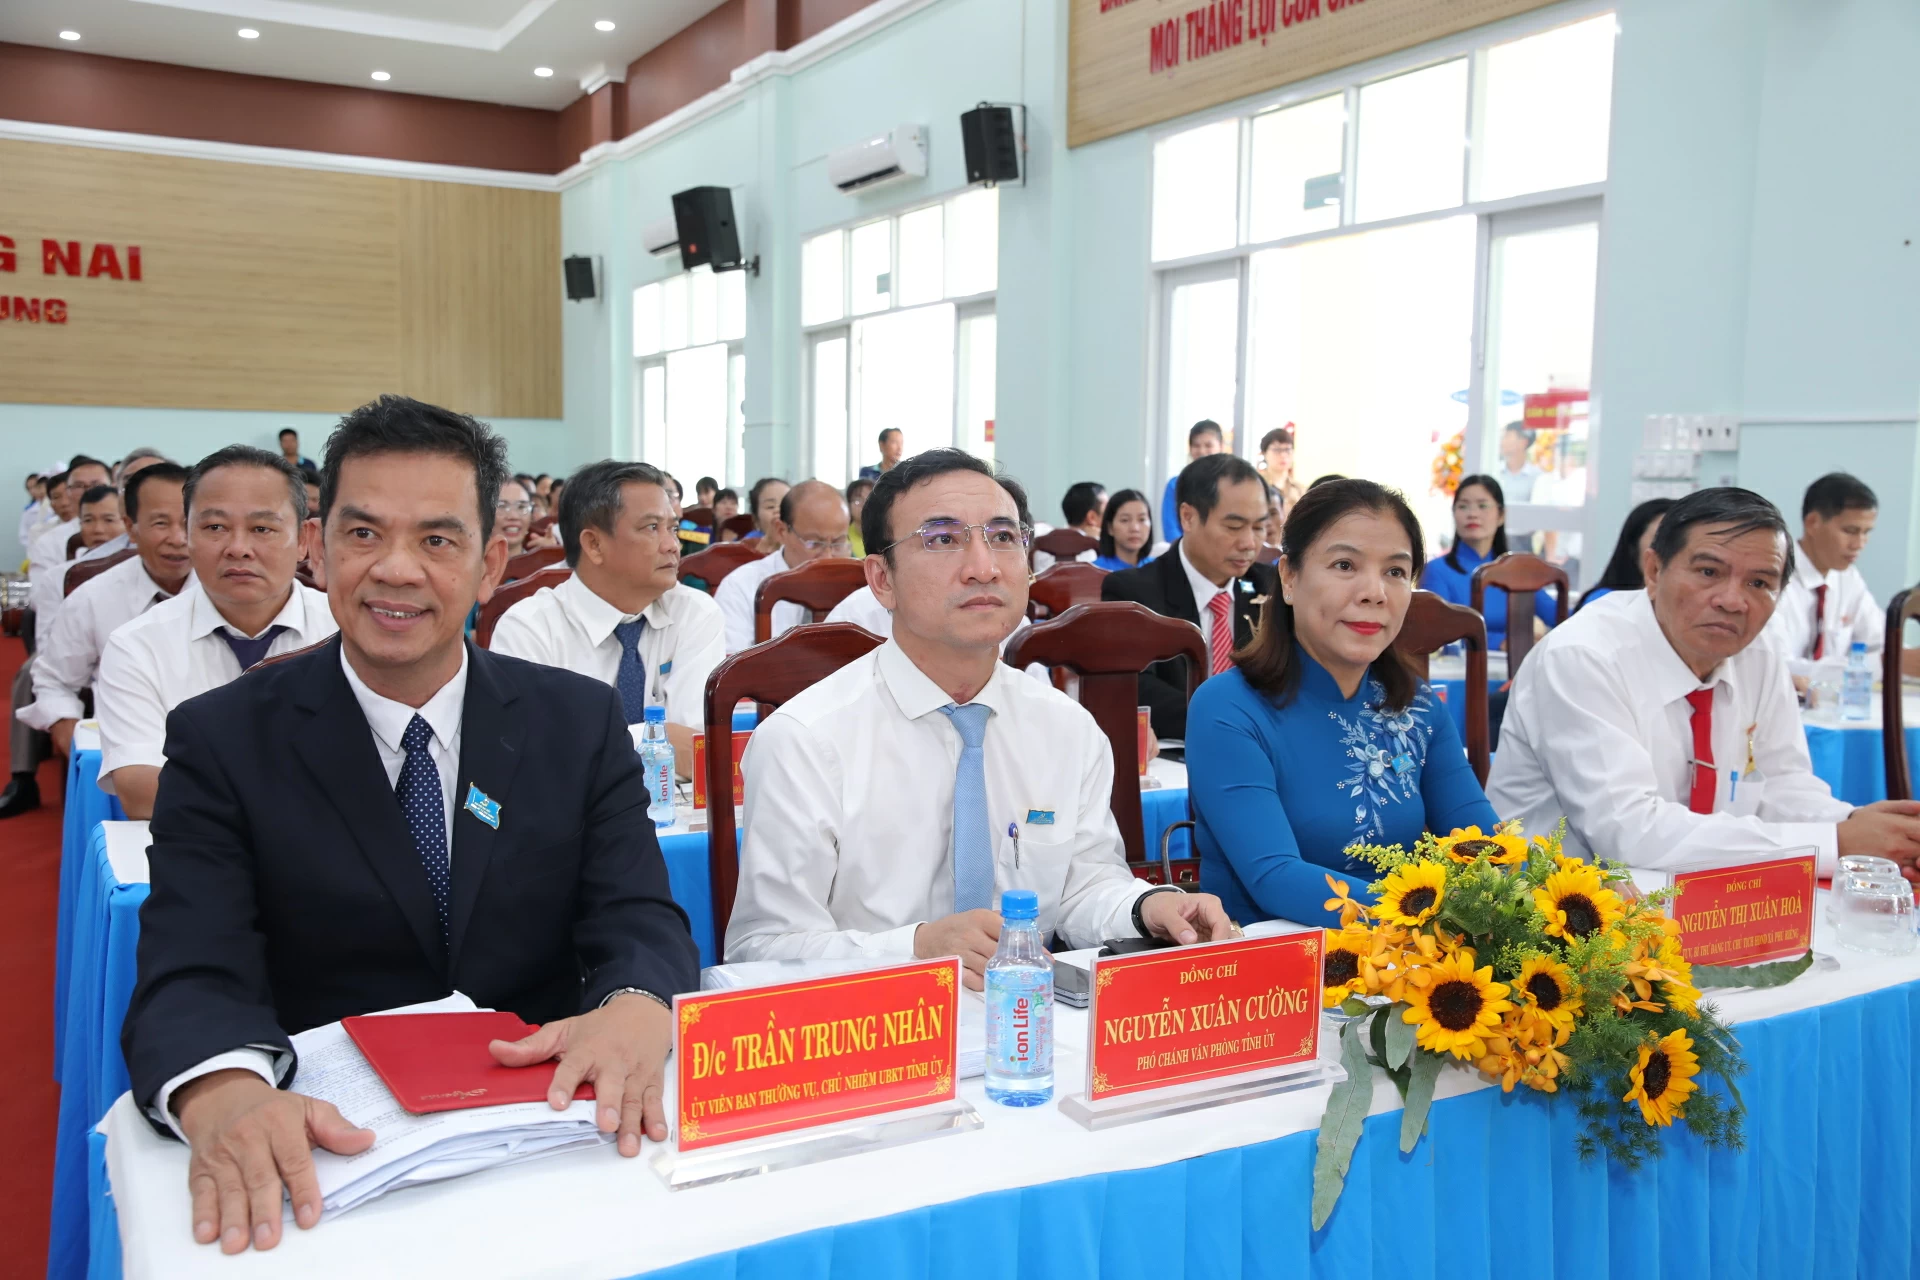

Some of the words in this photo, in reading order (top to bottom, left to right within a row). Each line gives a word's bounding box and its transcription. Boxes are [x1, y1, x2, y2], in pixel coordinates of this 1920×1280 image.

[42, 239, 142, 281] NAI
[1748, 876, 1762, 889] CHÍ
[1730, 904, 1748, 928] THỊ
[1749, 895, 1779, 922] XUÂN
[1180, 964, 1214, 985] ĐỒNG
[1216, 960, 1238, 977] CHÍ
[1013, 997, 1029, 1028] Life
[1104, 997, 1187, 1046] NGUYỄN
[1190, 994, 1242, 1032] XUÂN
[1245, 985, 1308, 1022] CƯỜNG
[692, 1040, 726, 1079] Đ/c
[732, 1010, 796, 1072] TRẦN
[801, 1015, 877, 1061] TRUNG
[882, 997, 944, 1048] NHÂN
[1137, 1050, 1156, 1071] PHÓ
[1158, 1047, 1189, 1067] CHÁNH
[1191, 1043, 1209, 1061] VĂN
[1210, 1036, 1239, 1059] PHÒNG
[1242, 1031, 1262, 1052] TỈNH
[1263, 1029, 1275, 1048] ỦY
[708, 1093, 734, 1114] VIÊN
[735, 1092, 756, 1110] BAN
[758, 1081, 801, 1105] THƯỜNG
[821, 1071, 842, 1095] CHỦ
[844, 1070, 877, 1092] NHIỆM
[879, 1065, 904, 1084] UBKT
[906, 1058, 929, 1080] TỈNH
[930, 1055, 944, 1075] ỦY
